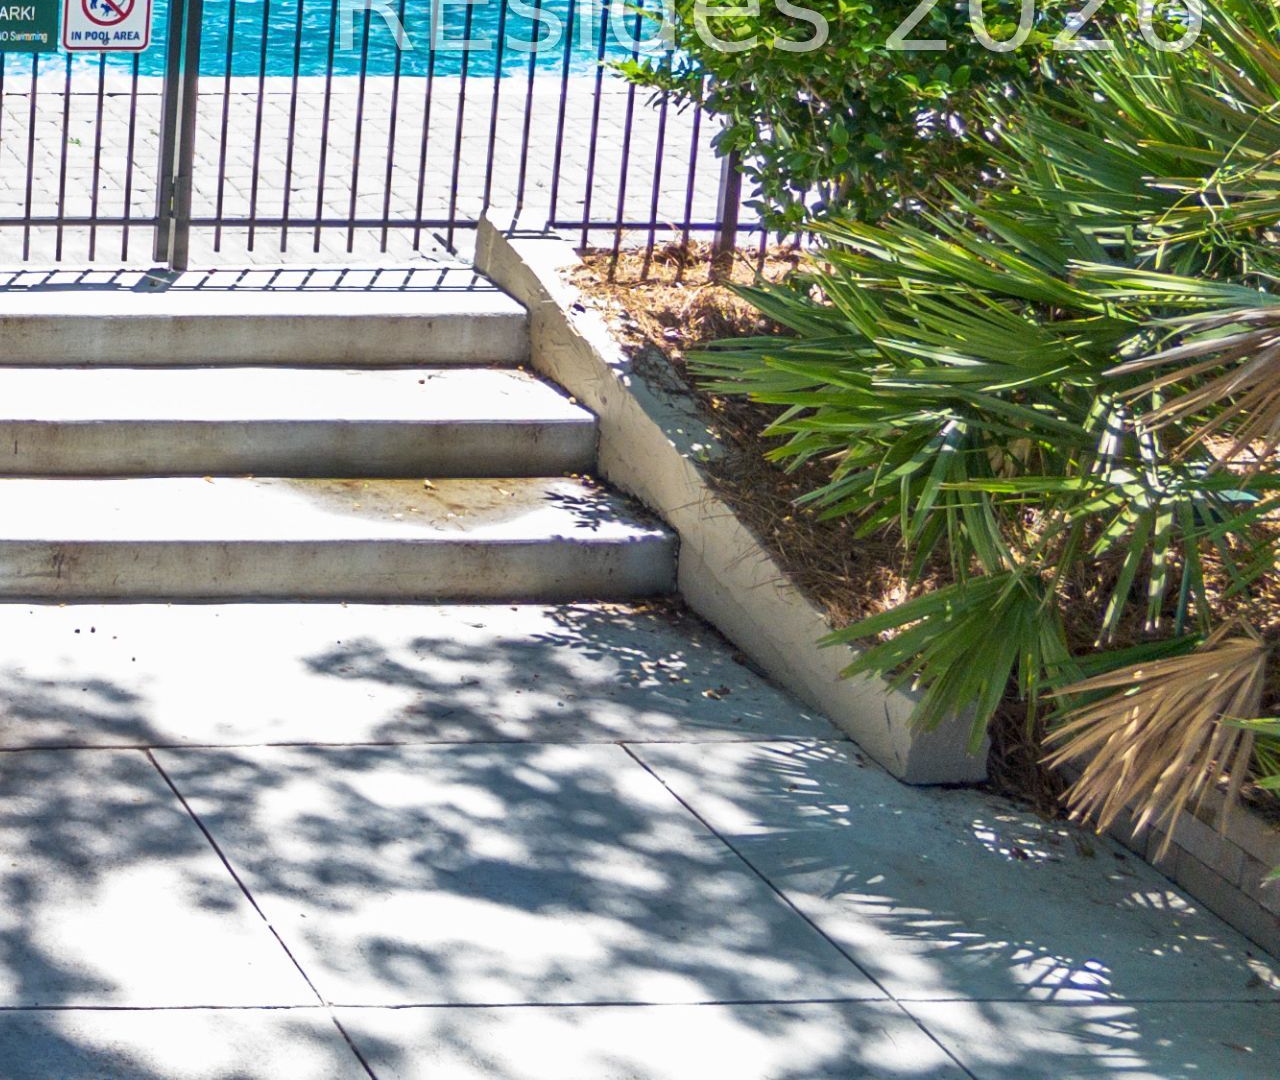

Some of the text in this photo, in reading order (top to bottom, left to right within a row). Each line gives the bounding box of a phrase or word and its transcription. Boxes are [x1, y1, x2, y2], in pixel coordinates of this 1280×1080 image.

[71, 31, 141, 41] IN POOL AREA
